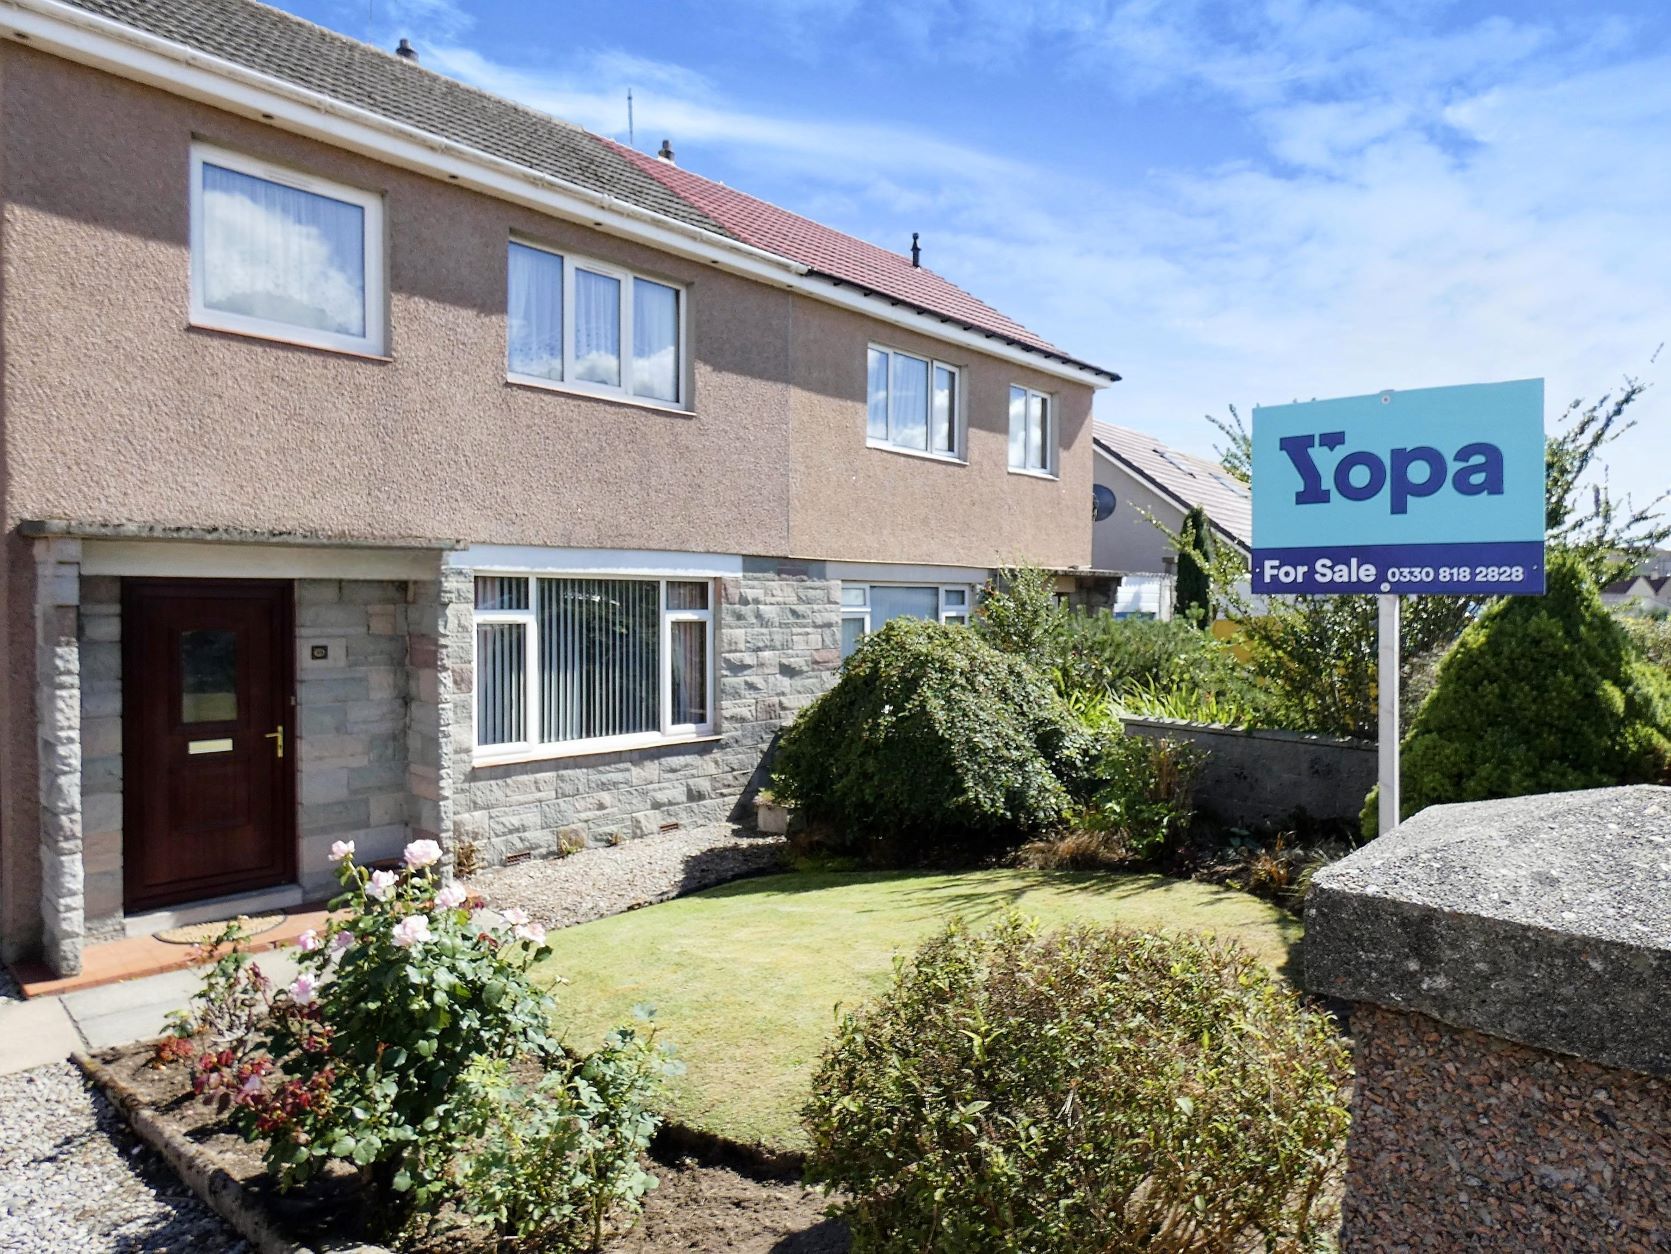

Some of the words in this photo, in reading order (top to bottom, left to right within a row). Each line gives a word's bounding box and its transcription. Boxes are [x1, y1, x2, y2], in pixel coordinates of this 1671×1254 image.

[1279, 431, 1504, 515] Yopa
[1263, 559, 1308, 583] For
[1314, 557, 1377, 582] Sale
[1387, 567, 1434, 582] 0330
[1438, 567, 1471, 582] 818
[1475, 565, 1524, 582] 2828
